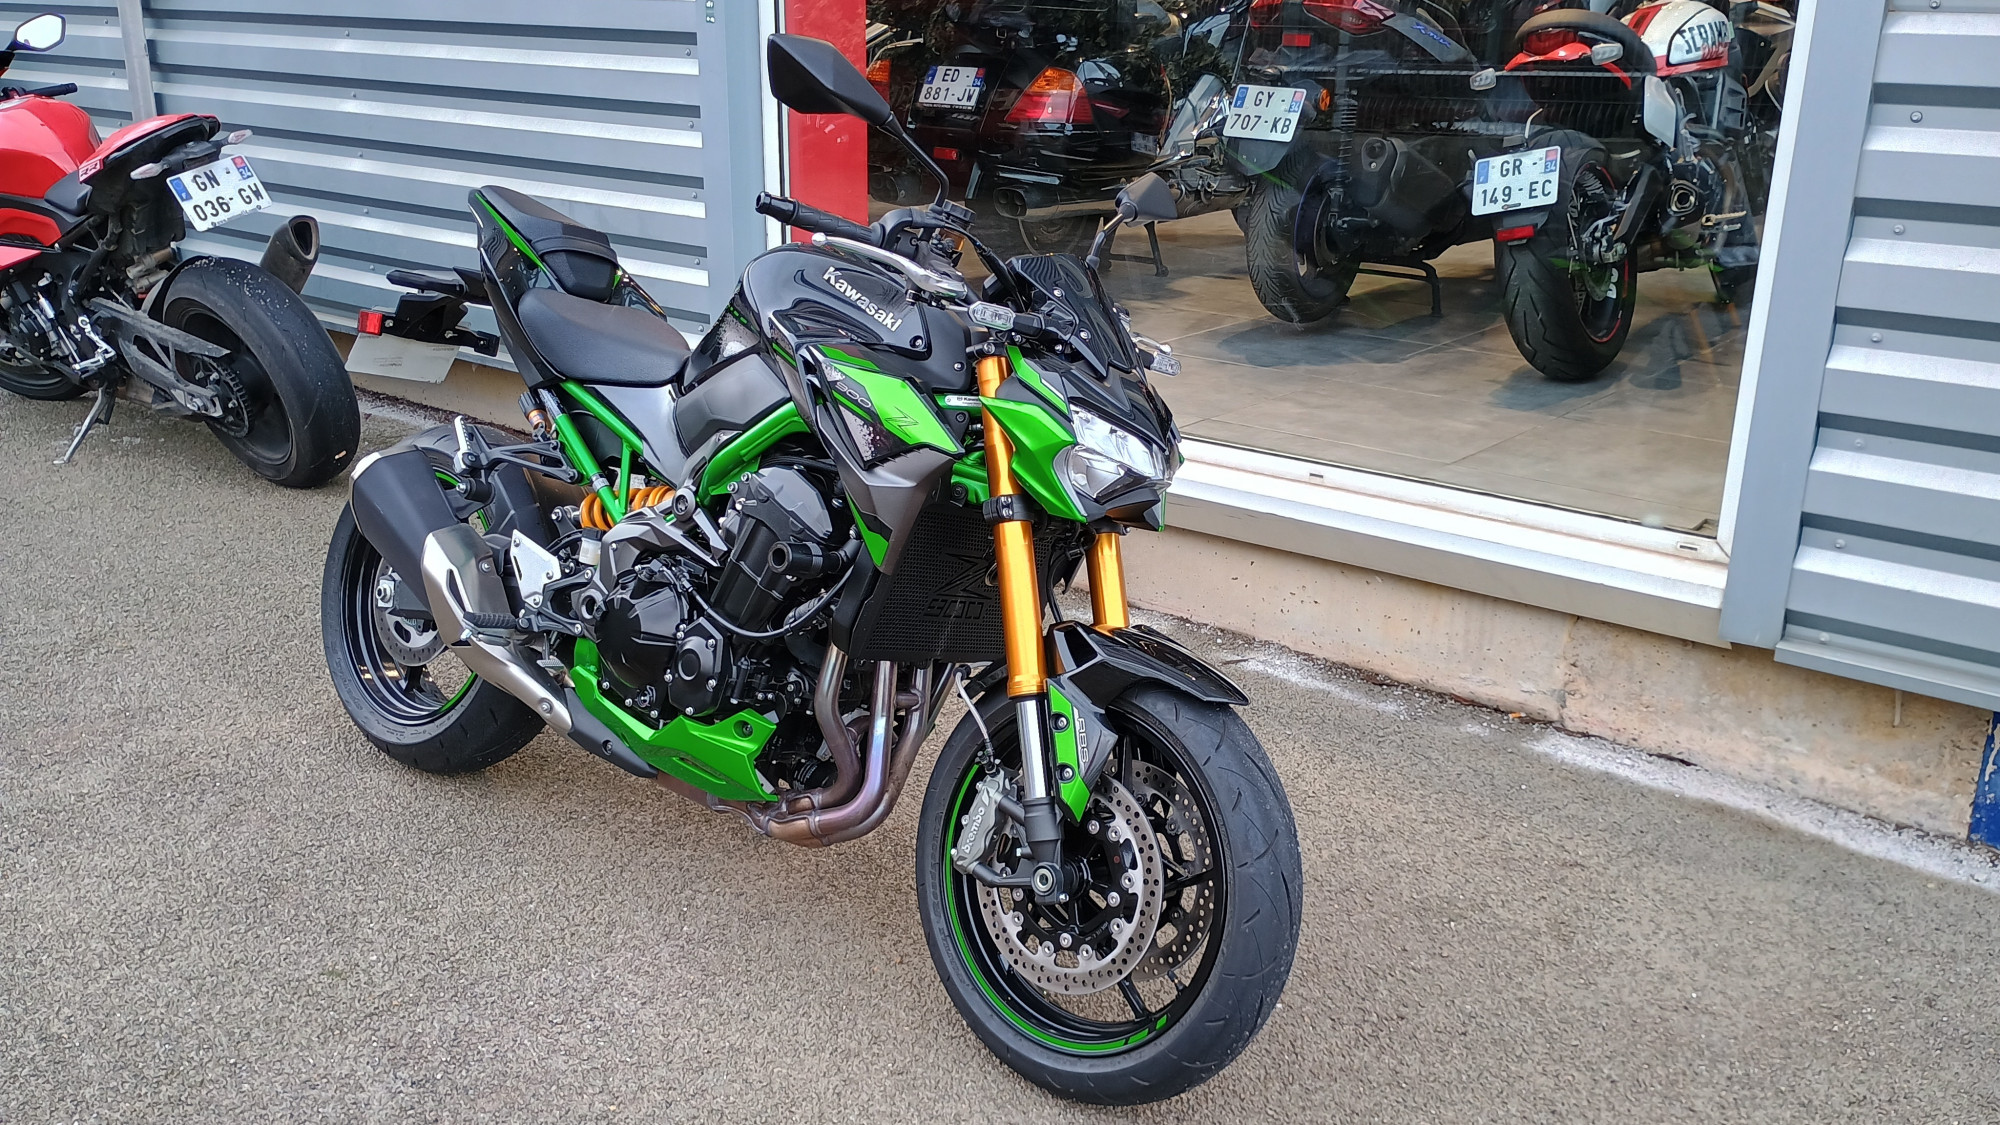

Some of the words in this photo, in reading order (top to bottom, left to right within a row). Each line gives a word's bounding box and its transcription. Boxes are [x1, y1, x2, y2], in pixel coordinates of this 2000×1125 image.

[1290, 102, 1299, 112] 34
[1230, 113, 1292, 134] 707-KB
[240, 166, 252, 179] 34
[1545, 161, 1556, 172] 34
[1481, 179, 1552, 207] 149-EC
[823, 266, 903, 332] Kawasaki
[835, 381, 872, 408] 900
[923, 599, 985, 620] 900
[1077, 717, 1089, 763] ABS
[961, 806, 985, 854] brembo
